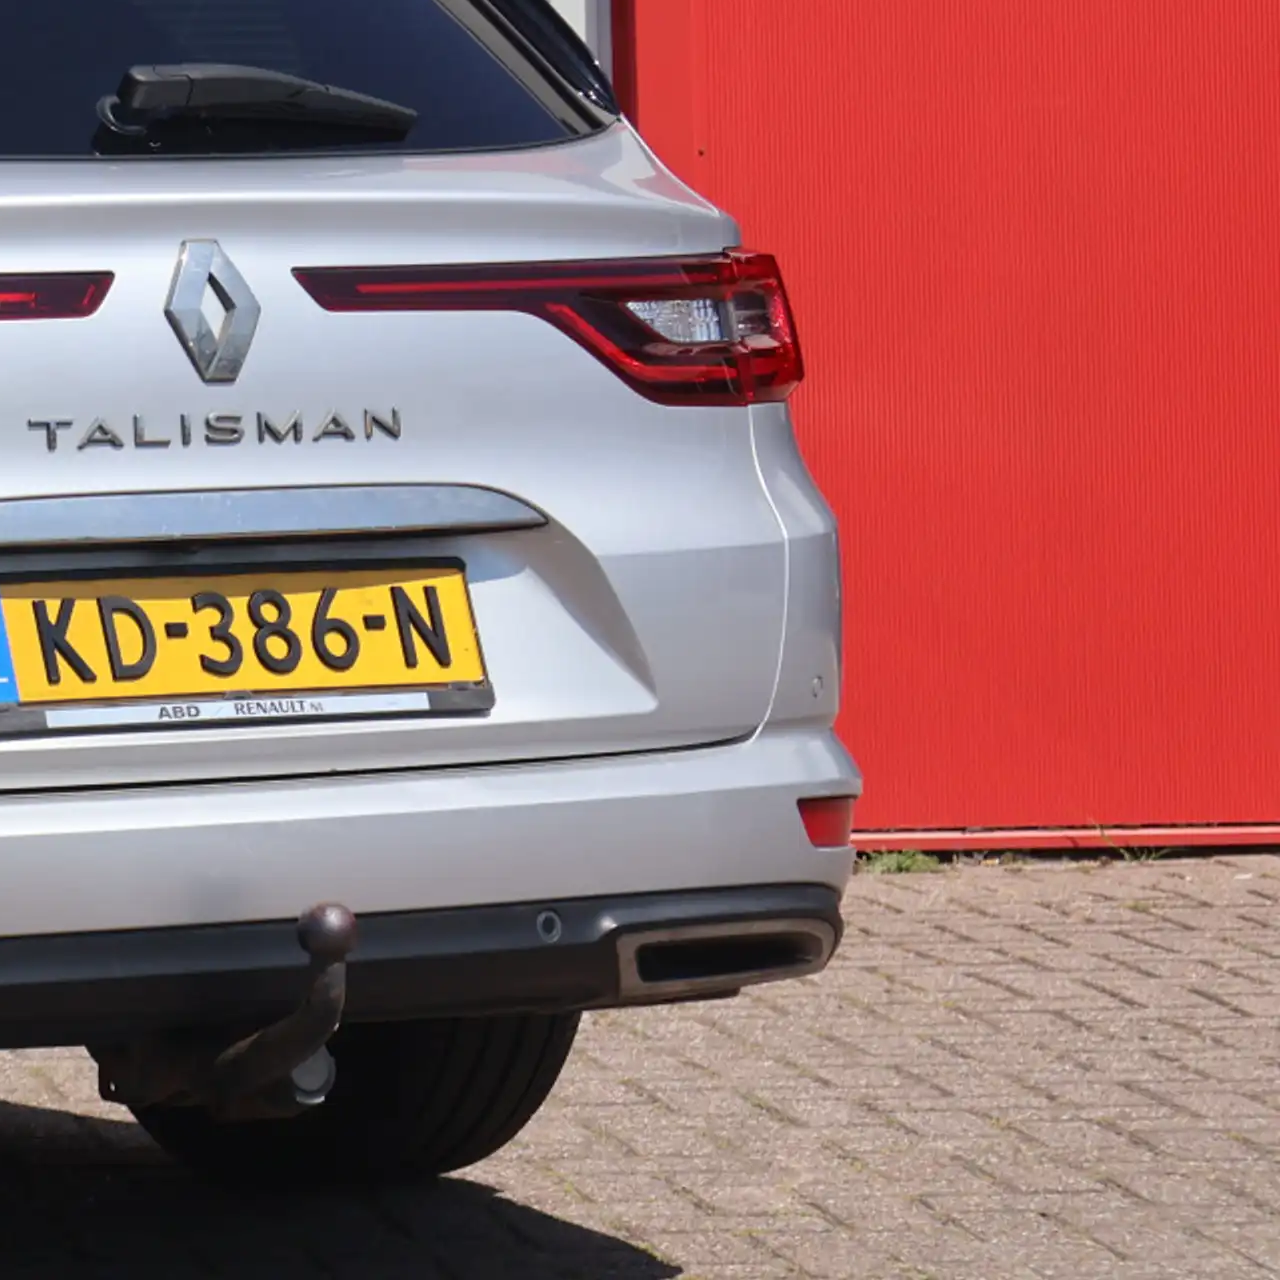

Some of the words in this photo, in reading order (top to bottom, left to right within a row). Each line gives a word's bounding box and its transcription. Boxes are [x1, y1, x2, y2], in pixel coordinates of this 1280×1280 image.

[26, 407, 402, 454] TALISMAN
[32, 585, 452, 685] KD-386-N
[157, 703, 201, 720] ABD
